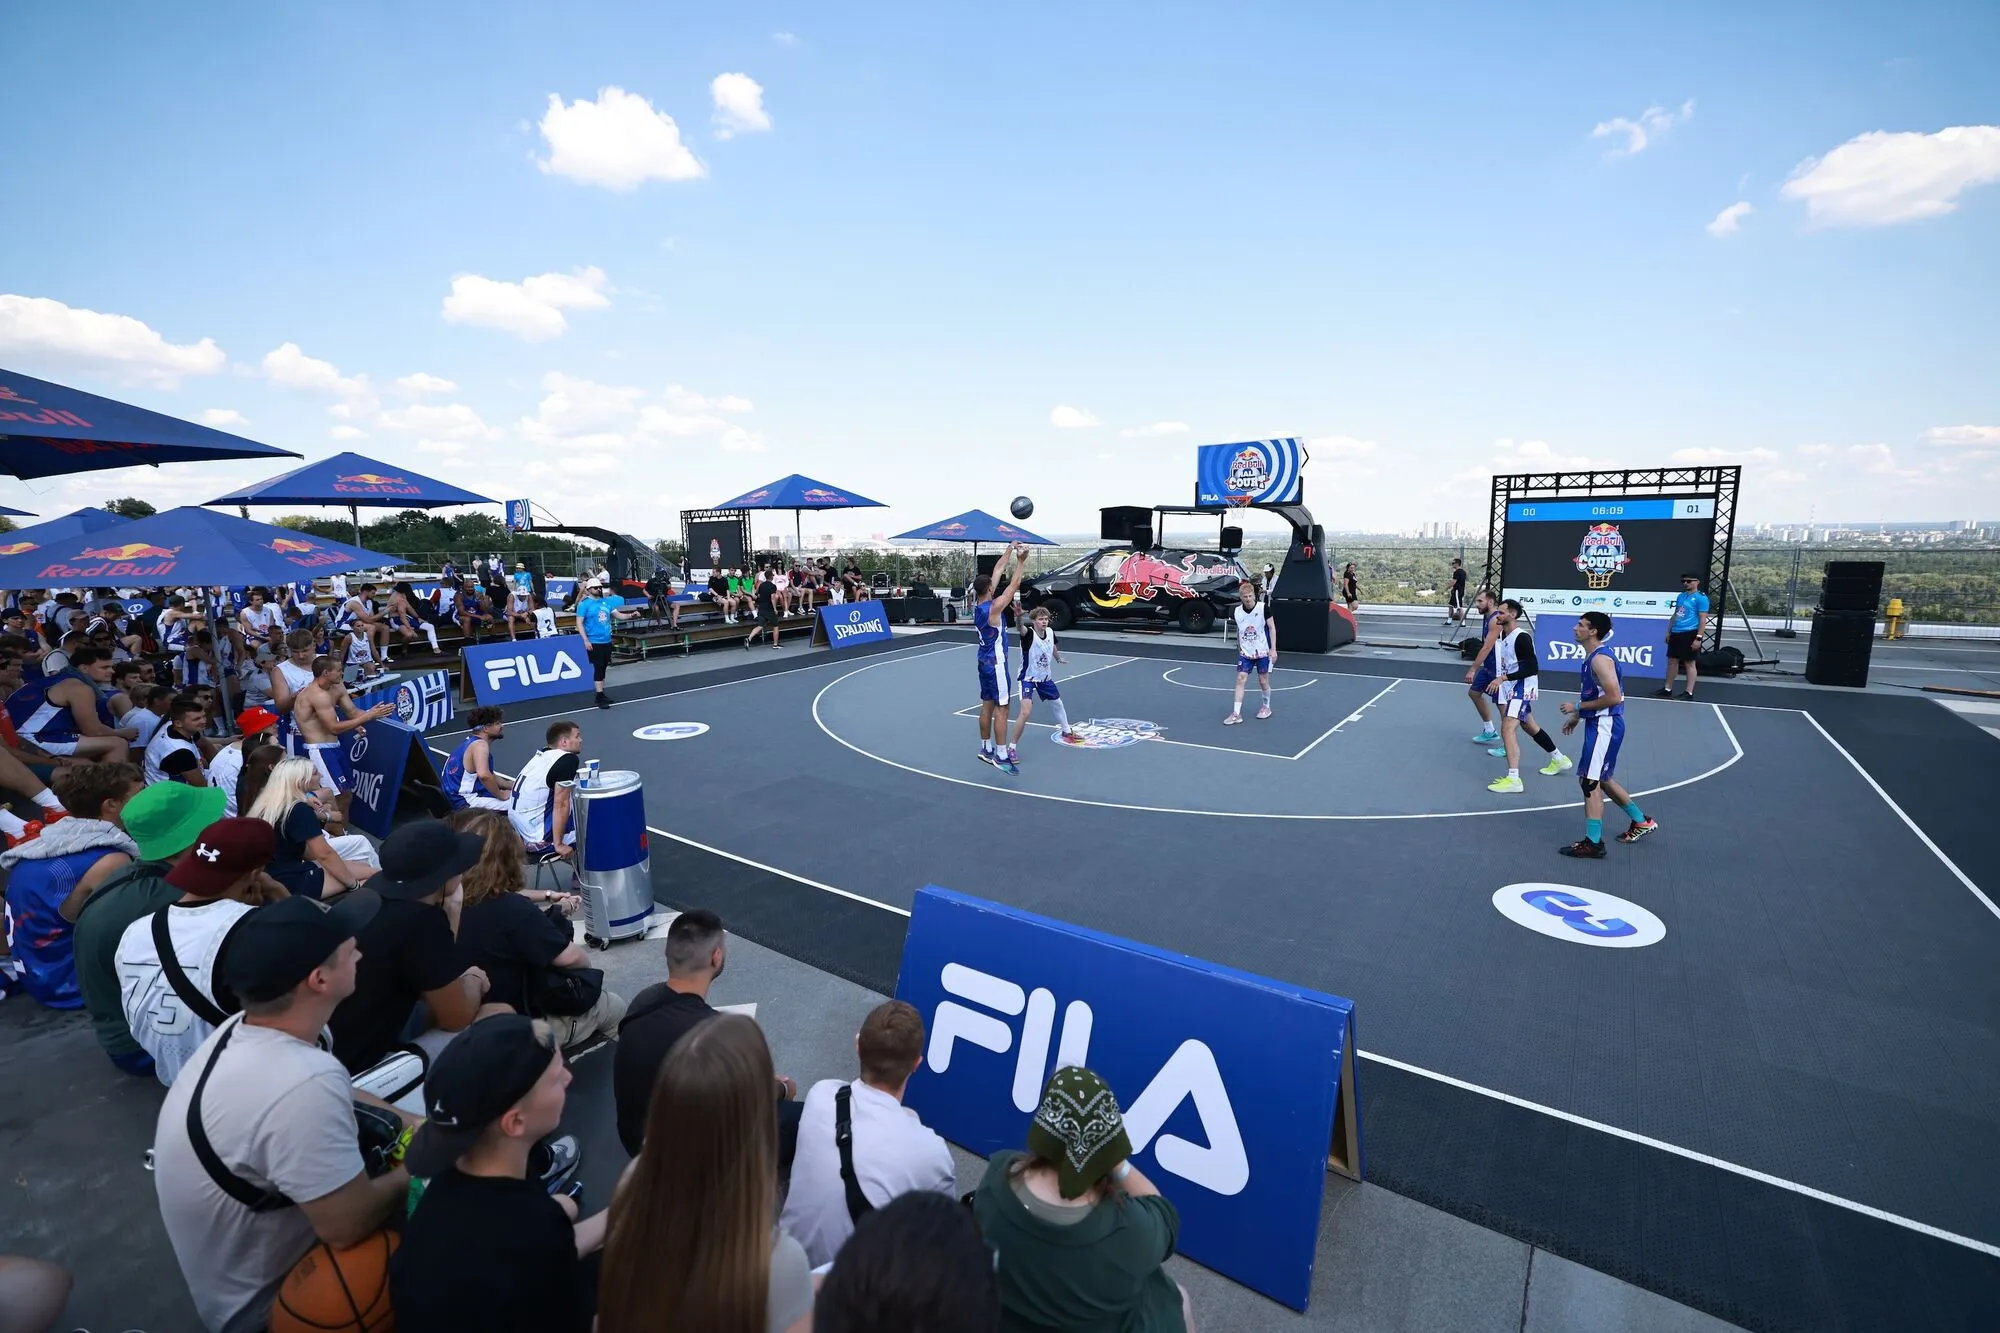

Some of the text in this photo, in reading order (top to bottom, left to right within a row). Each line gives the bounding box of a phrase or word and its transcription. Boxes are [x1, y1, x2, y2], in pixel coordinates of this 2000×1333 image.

[333, 484, 421, 494] Red Bull
[1229, 475, 1266, 490] COURT
[1522, 508, 1536, 516] 00
[1592, 506, 1624, 515] 06:09
[1686, 504, 1700, 513] 01
[1584, 536, 1621, 545] Red Bull
[1578, 553, 1625, 571] COURT
[36, 561, 178, 579] Red Bull
[1195, 564, 1236, 575] Red Bull
[544, 618, 552, 631] 2
[833, 618, 885, 640] SPALDING
[1547, 640, 1654, 667] SPAING
[484, 650, 582, 691] FILA
